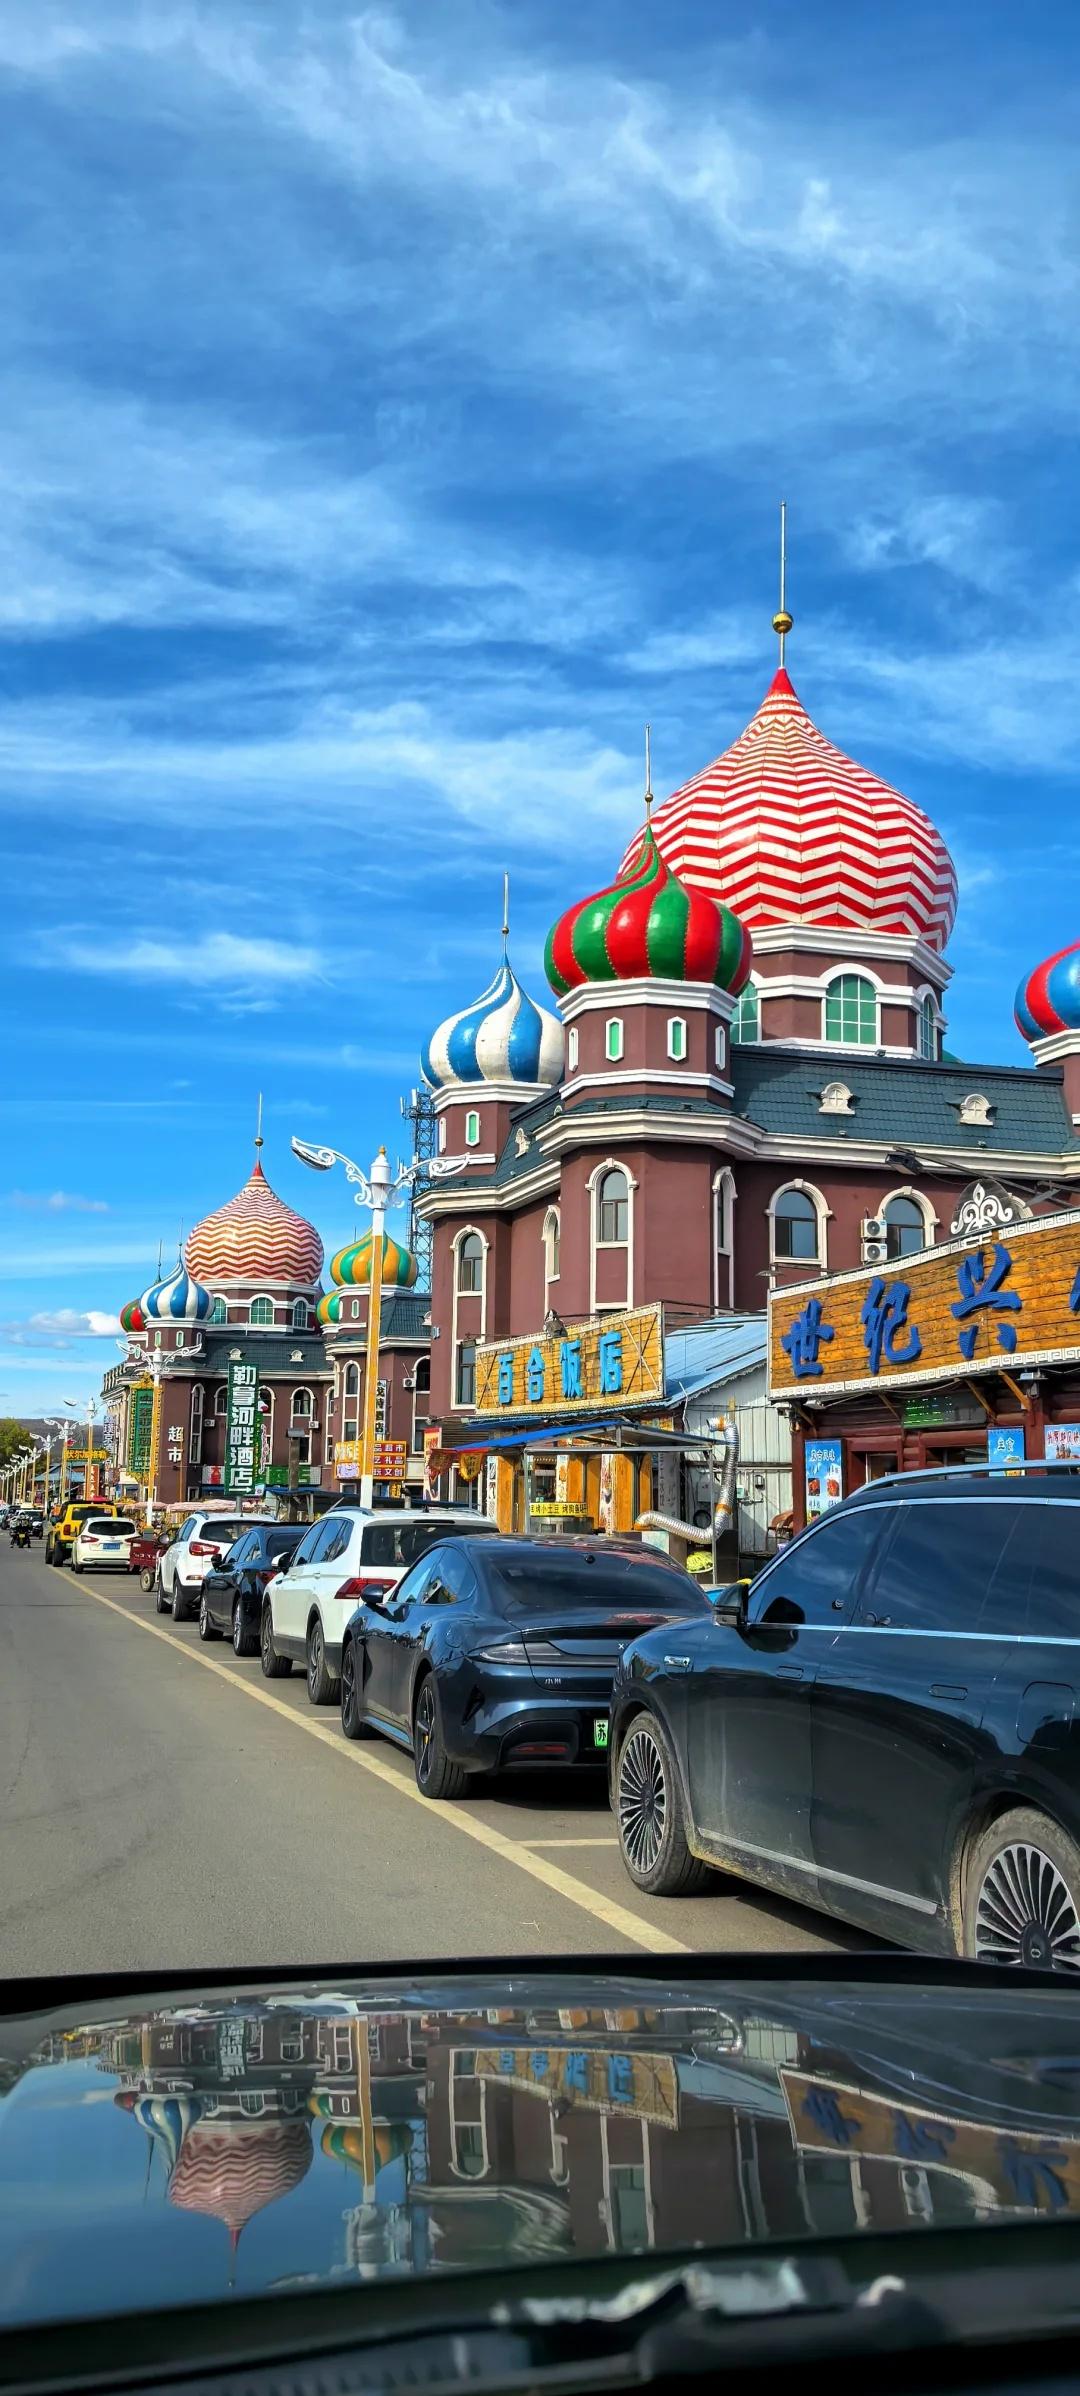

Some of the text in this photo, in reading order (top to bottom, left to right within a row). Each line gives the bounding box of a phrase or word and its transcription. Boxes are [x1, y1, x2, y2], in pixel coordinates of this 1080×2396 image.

[781, 1243, 1080, 1379] 世纪兴
[497, 1329, 624, 1405] 百合饭店
[168, 1426, 184, 1463] 超市
[229, 1365, 256, 1487] 勒拿河畔酒店
